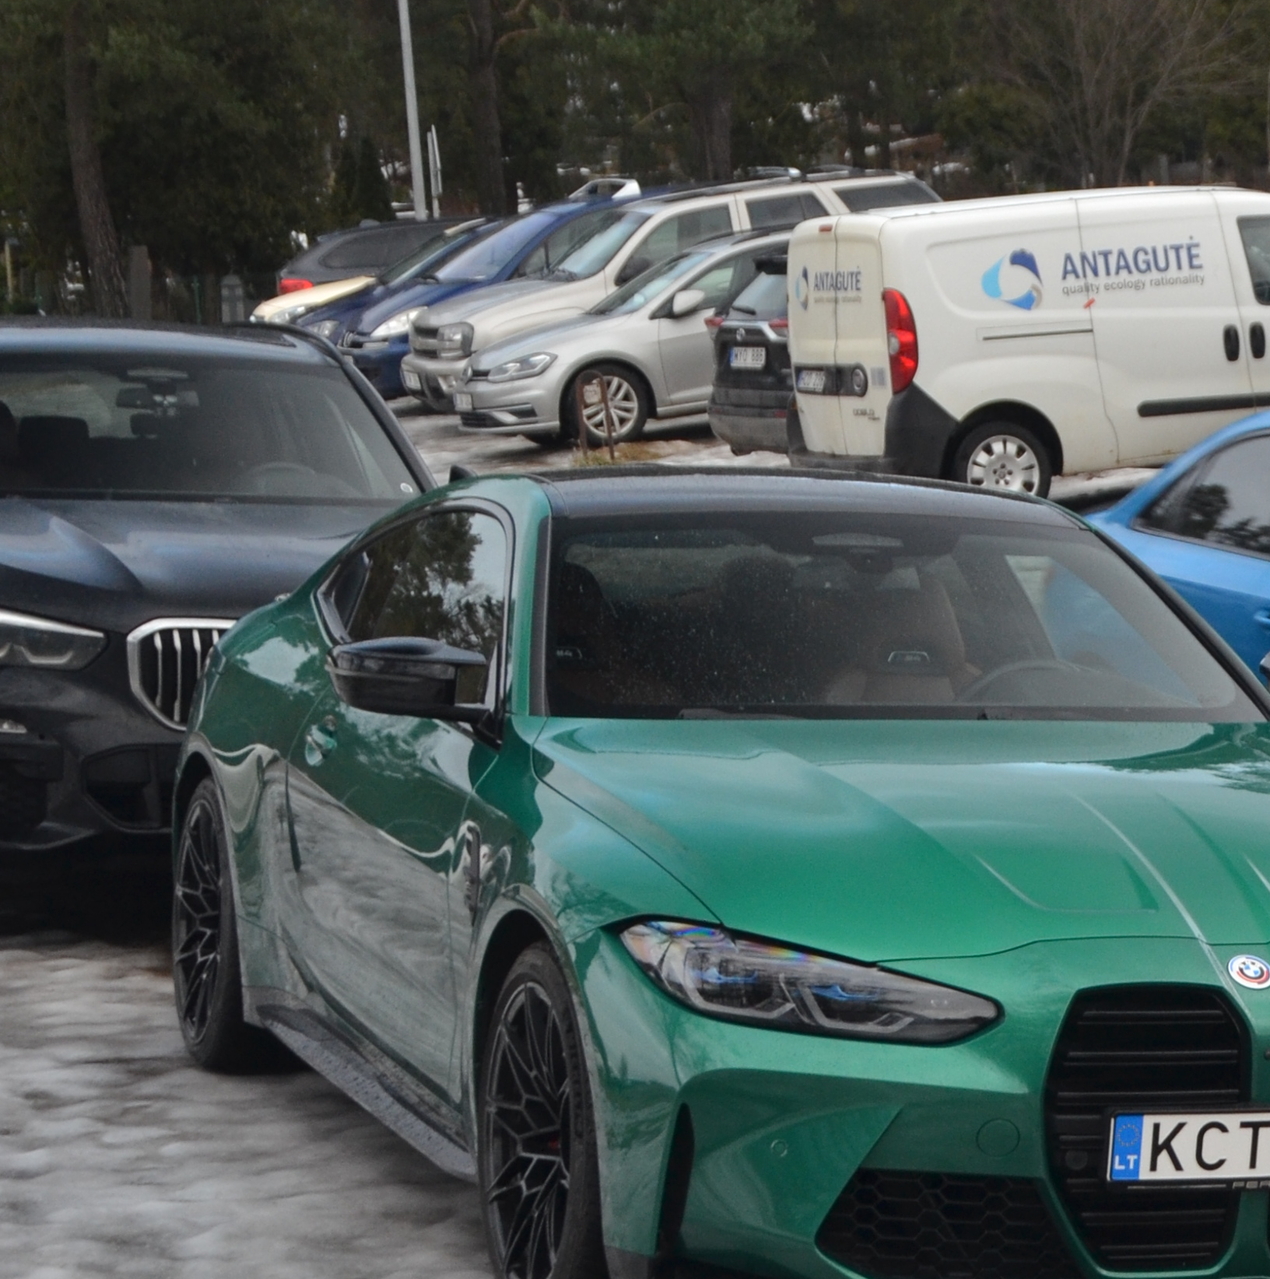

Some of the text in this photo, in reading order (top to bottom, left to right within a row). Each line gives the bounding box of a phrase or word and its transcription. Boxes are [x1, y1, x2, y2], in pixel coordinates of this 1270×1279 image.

[1062, 235, 1203, 280] ANTAGUTĖ
[813, 265, 862, 291] ANTAGUTĖ
[1062, 273, 1205, 296] quality ecology rationality
[1114, 1154, 1138, 1170] LT
